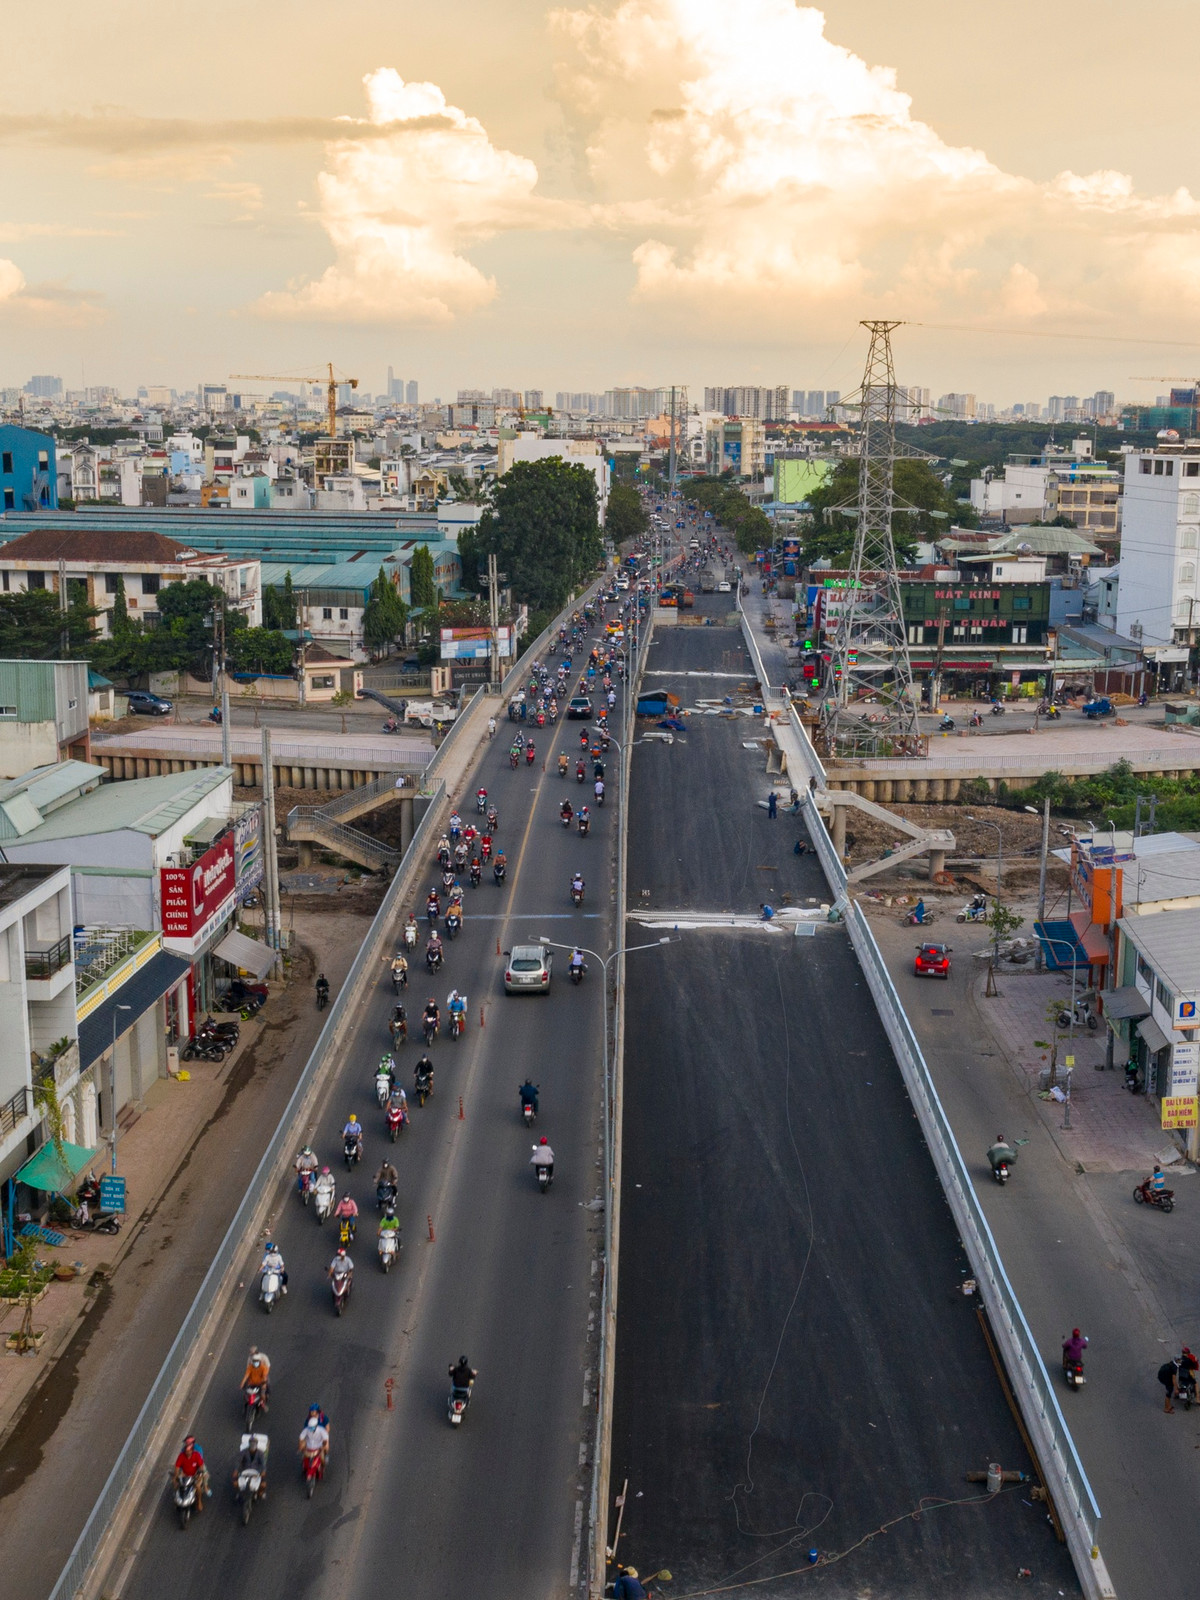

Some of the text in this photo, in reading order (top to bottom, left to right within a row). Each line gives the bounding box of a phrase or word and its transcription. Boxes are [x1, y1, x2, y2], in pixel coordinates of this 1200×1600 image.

[969, 587, 1001, 600] KÍNH
[165, 873, 186, 882] 100%
[166, 910, 188, 919] CHÍNH
